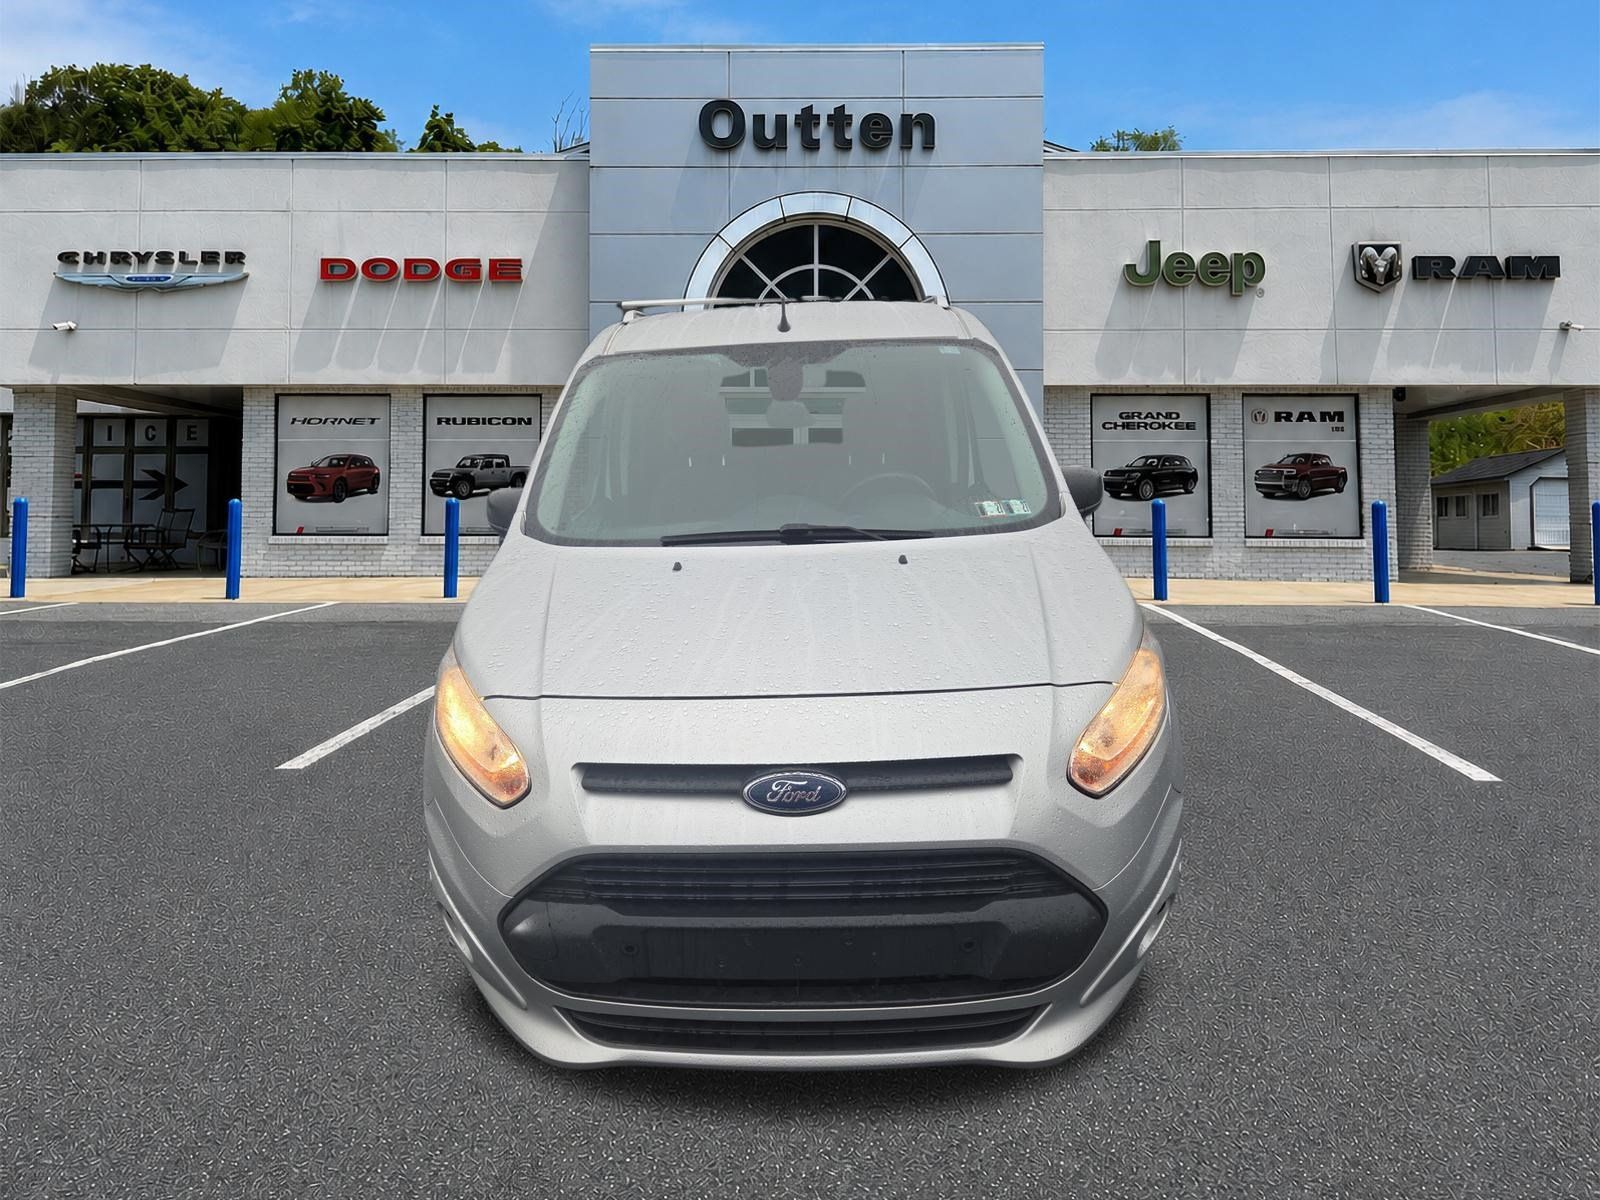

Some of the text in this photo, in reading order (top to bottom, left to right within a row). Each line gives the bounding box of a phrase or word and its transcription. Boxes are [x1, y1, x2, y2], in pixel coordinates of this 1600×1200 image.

[698, 99, 936, 150] Outten
[57, 250, 247, 265] CHRYSLER
[320, 257, 523, 282] DODGE
[1123, 240, 1266, 296] Jeep
[1411, 255, 1561, 280] RAM
[290, 416, 382, 426] HORNET
[436, 416, 534, 426] RUBICON
[1118, 411, 1181, 420] GRAND
[1274, 411, 1345, 422] RAM
[1101, 421, 1197, 430] CHEROKEE
[766, 779, 822, 803] Ford
